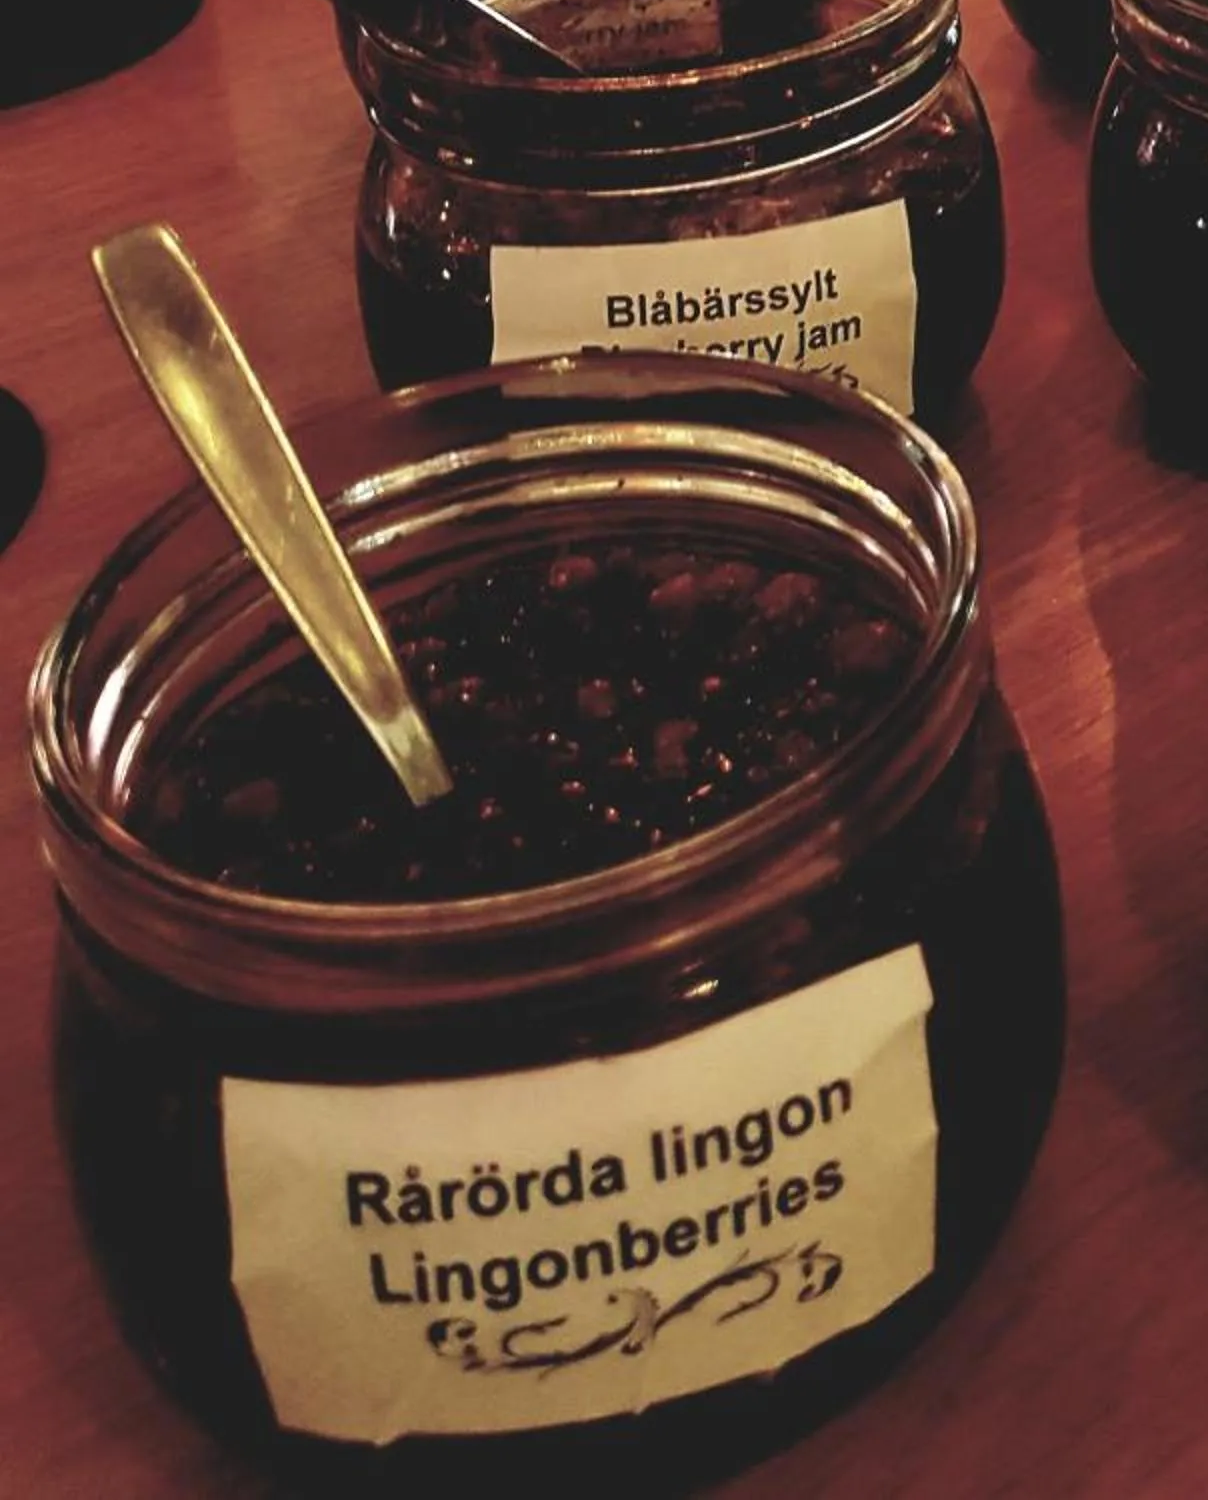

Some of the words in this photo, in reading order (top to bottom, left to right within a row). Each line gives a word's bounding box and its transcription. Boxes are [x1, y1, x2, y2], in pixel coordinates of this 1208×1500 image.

[606, 268, 839, 330] Blåbärssylt
[795, 314, 861, 362] jam
[345, 1148, 627, 1228] Rårörda
[650, 1076, 853, 1181] lingon
[369, 1158, 846, 1310] Lingonberries
